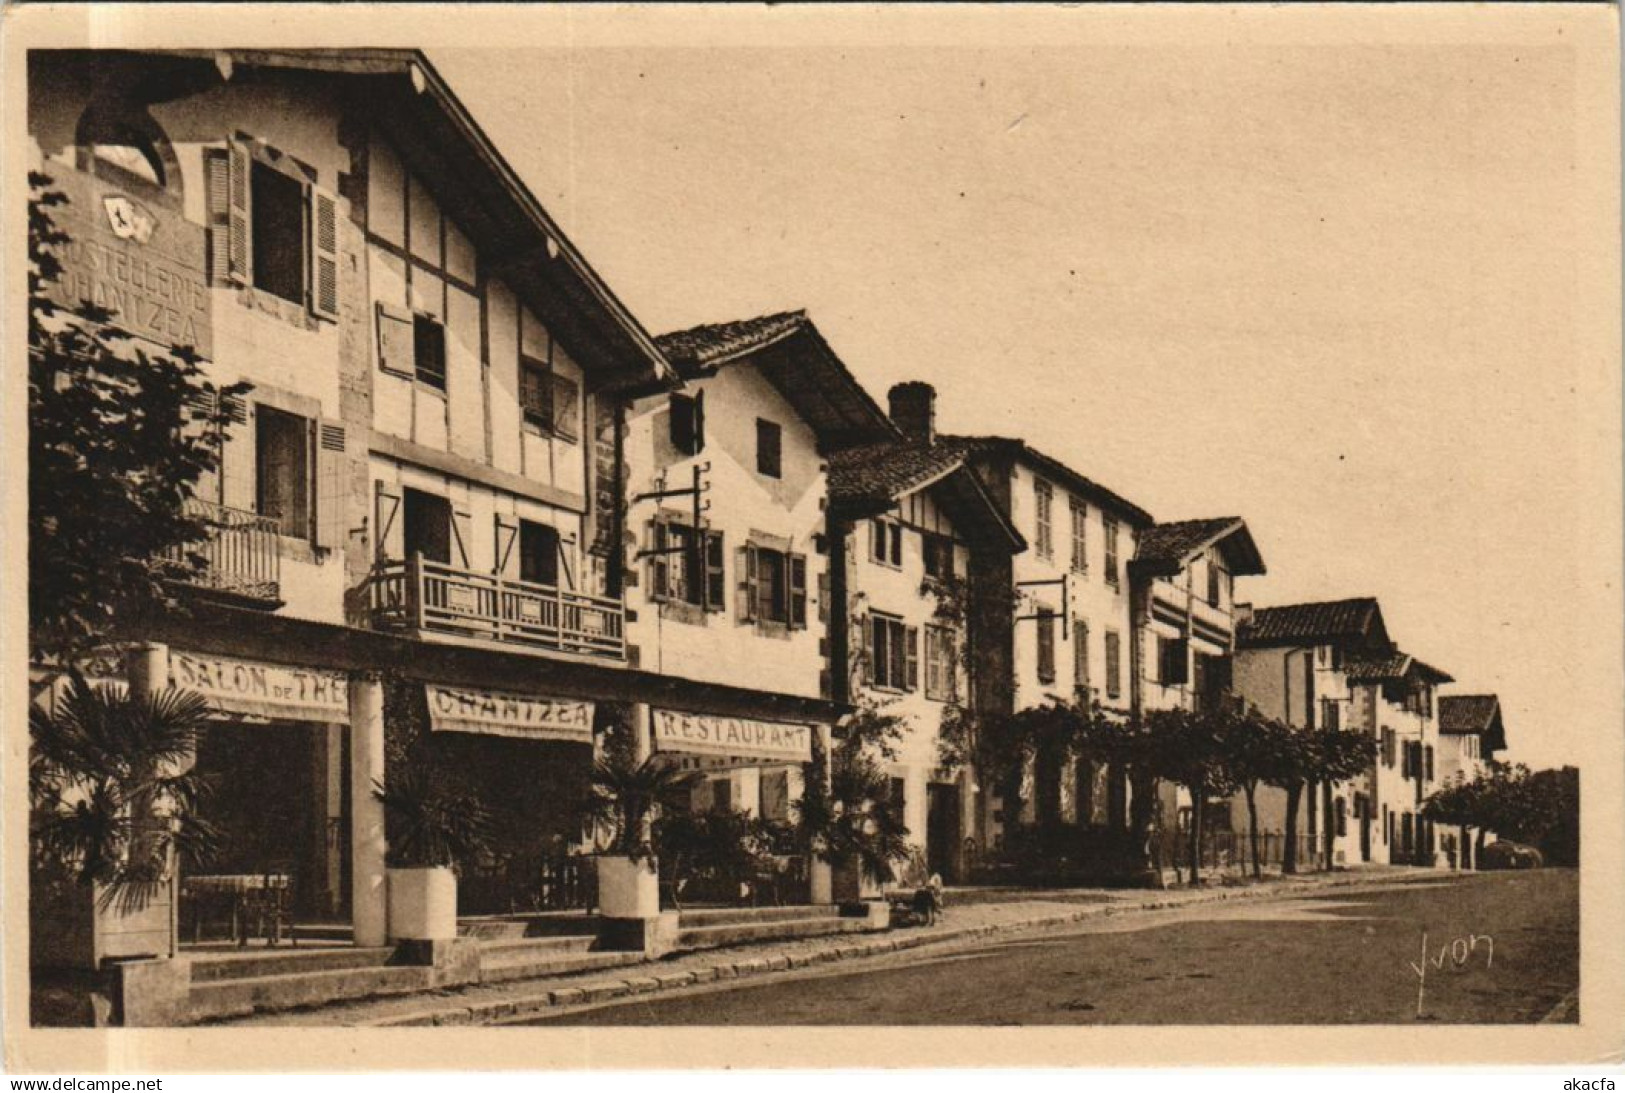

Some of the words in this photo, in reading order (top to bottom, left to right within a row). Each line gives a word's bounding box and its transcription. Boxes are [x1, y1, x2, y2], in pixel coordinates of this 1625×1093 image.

[61, 236, 206, 312] OSTELLERIE
[179, 656, 268, 697] SALON
[273, 685, 293, 699] DE
[662, 712, 805, 749] RESTAURANT
